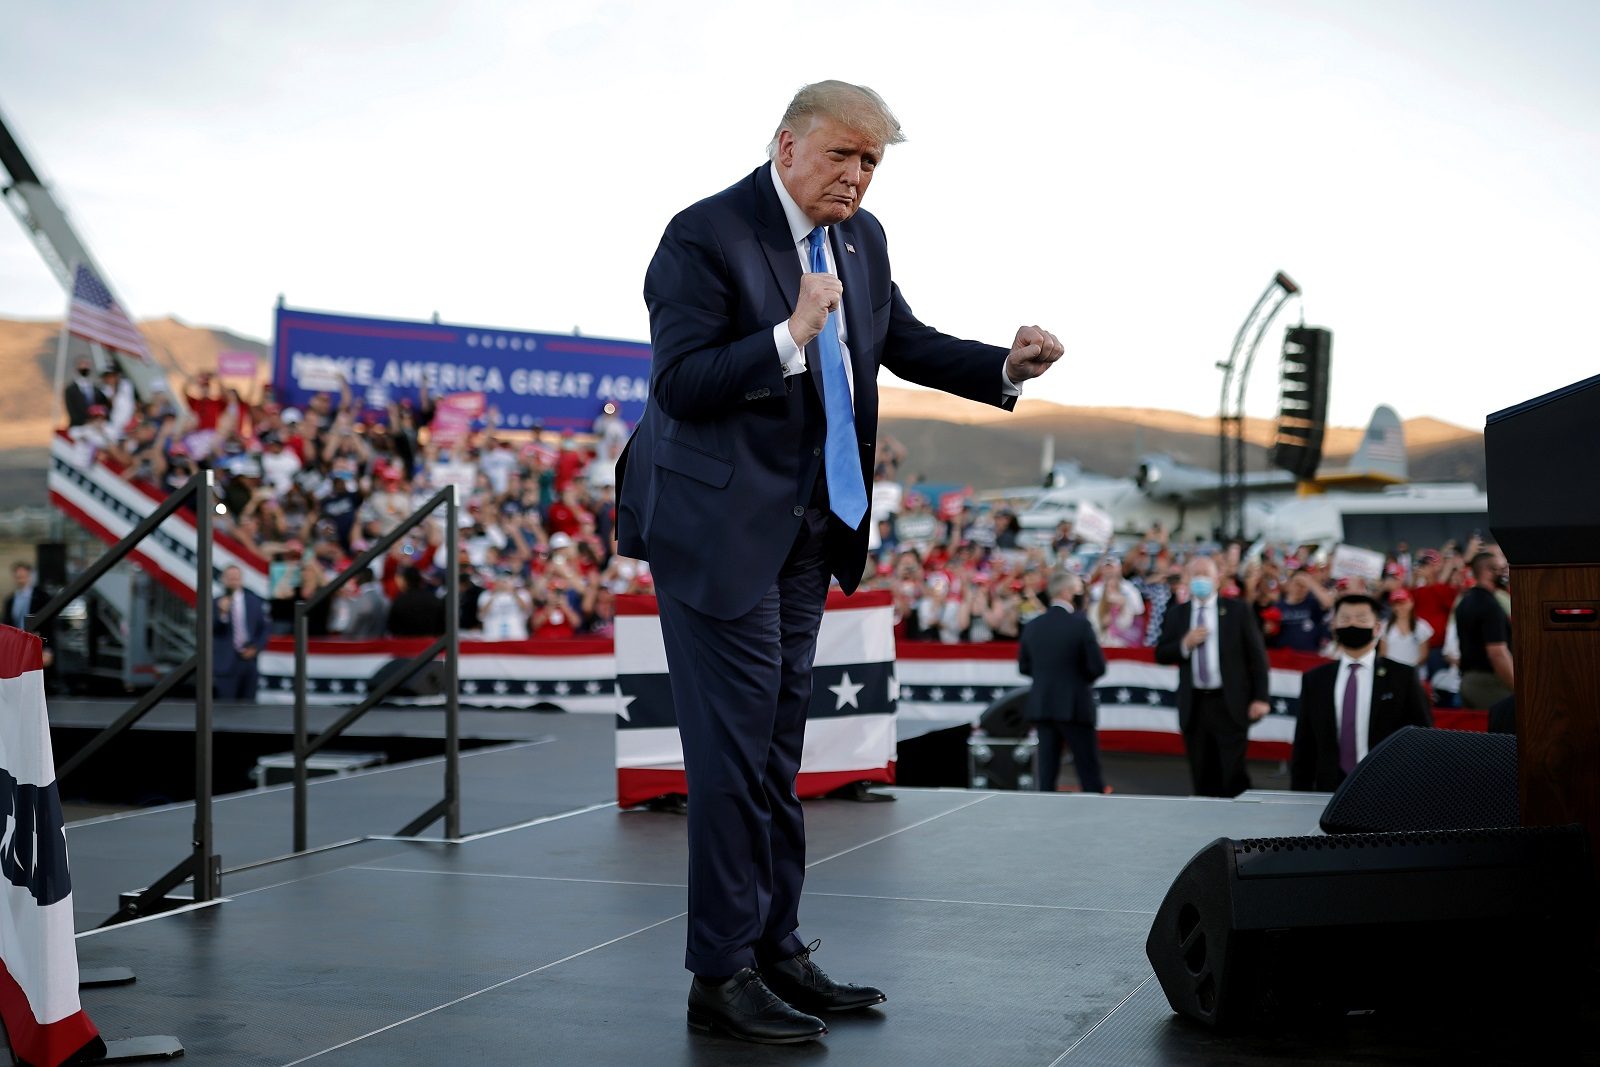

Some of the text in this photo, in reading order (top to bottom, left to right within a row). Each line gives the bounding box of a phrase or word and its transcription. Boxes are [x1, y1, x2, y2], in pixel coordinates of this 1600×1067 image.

[291, 352, 649, 402] KE AMERICA GREAT AGA
